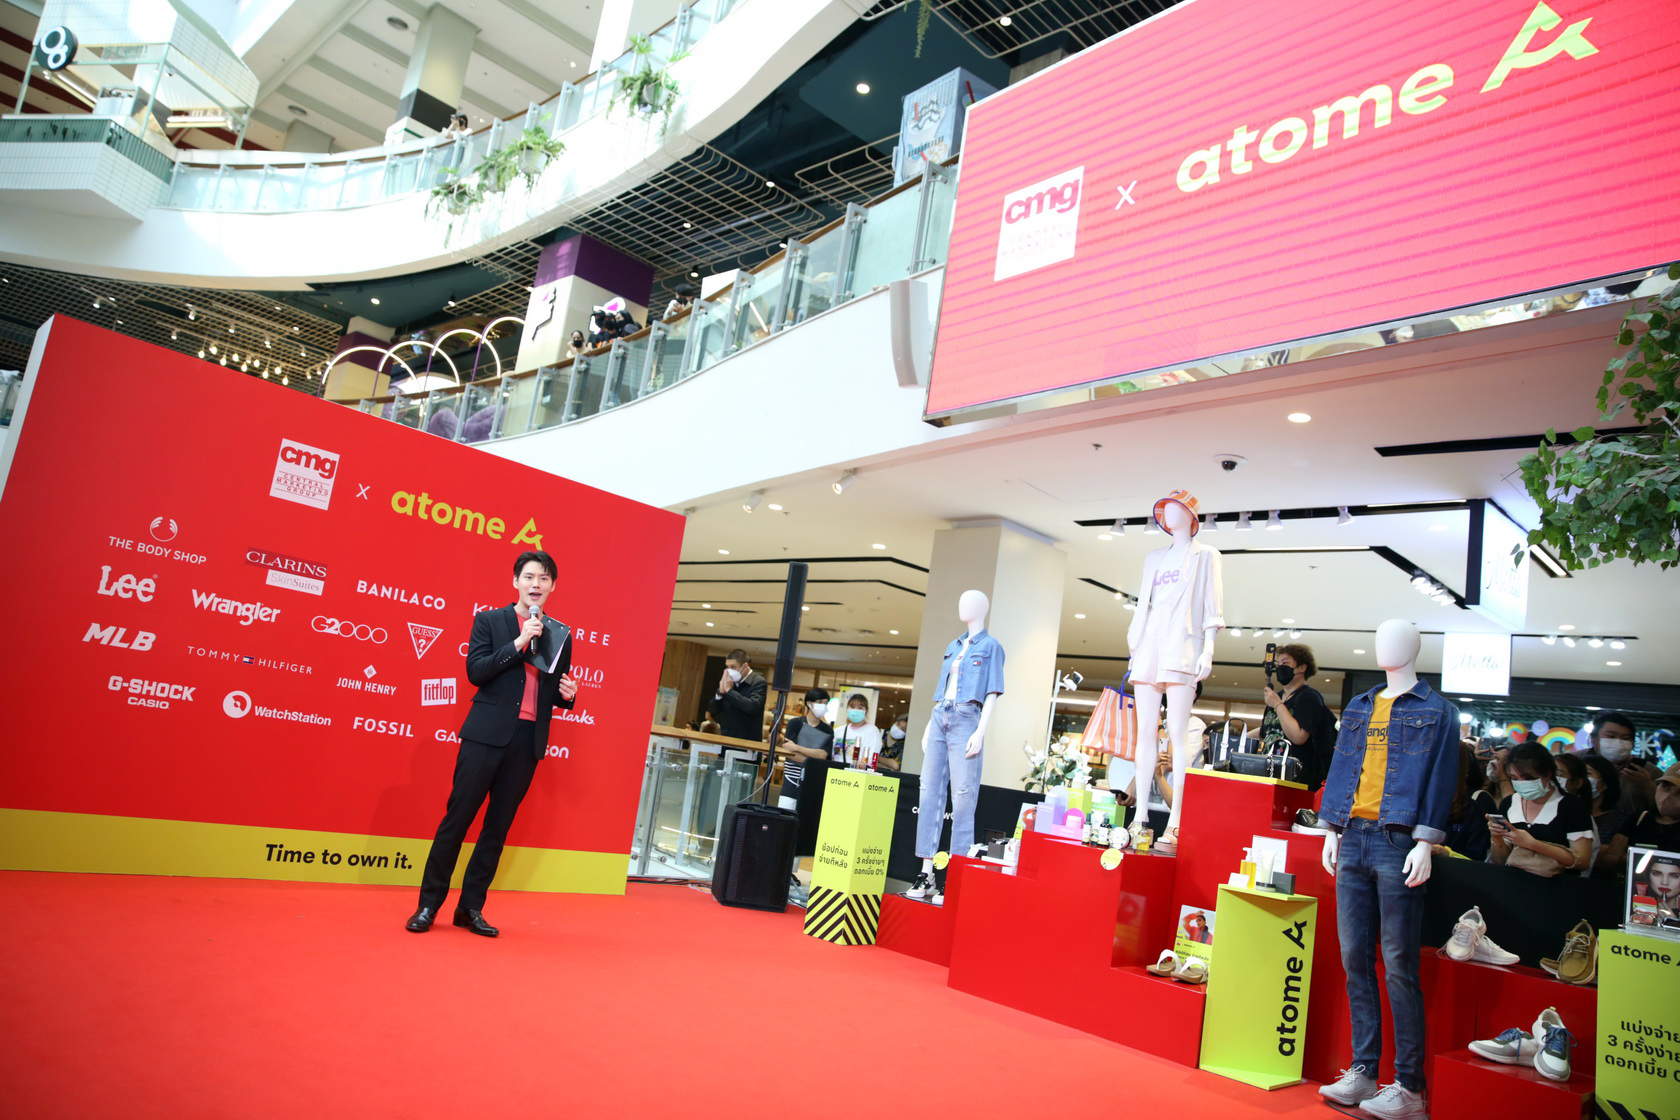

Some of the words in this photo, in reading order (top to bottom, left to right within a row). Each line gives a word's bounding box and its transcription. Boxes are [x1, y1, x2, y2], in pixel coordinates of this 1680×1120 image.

[1005, 178, 1080, 224] cmg
[1176, 63, 1455, 193] atome
[276, 477, 329, 496] MARKETING
[284, 473, 324, 489] CENTRAL
[286, 486, 316, 498] GROUP
[280, 446, 337, 479] cmg
[391, 490, 506, 540] atome
[109, 536, 134, 550] THE
[137, 542, 172, 558] BODY
[173, 550, 207, 565] SHOP
[246, 551, 328, 578] CLARINS
[97, 565, 157, 603] Lee
[1153, 569, 1180, 586] Lee
[191, 589, 281, 626] Wrangler
[82, 622, 157, 652] MLB
[311, 615, 388, 645] G2000
[412, 626, 437, 638] GUESS
[575, 628, 611, 646] REE
[187, 645, 240, 662] TOMMY
[258, 657, 313, 675] HILFIGER
[108, 675, 197, 702] G-SHOCK
[336, 676, 362, 691] JOHN
[364, 682, 397, 696] HENRY
[424, 679, 454, 704] fitflop
[127, 696, 170, 710] CASIO
[255, 705, 332, 727] WatchStation
[353, 716, 415, 738] FOSSIL
[830, 778, 852, 787] atome
[868, 784, 888, 792] atome
[265, 843, 316, 864] Time
[321, 849, 342, 866] to
[347, 853, 389, 868] own
[393, 851, 413, 870] it.
[1611, 945, 1672, 965] atome
[1276, 956, 1304, 1057] atome
[1607, 1034, 1618, 1047] 3
[1605, 1054, 1667, 1078] ดอกเบี้ย
